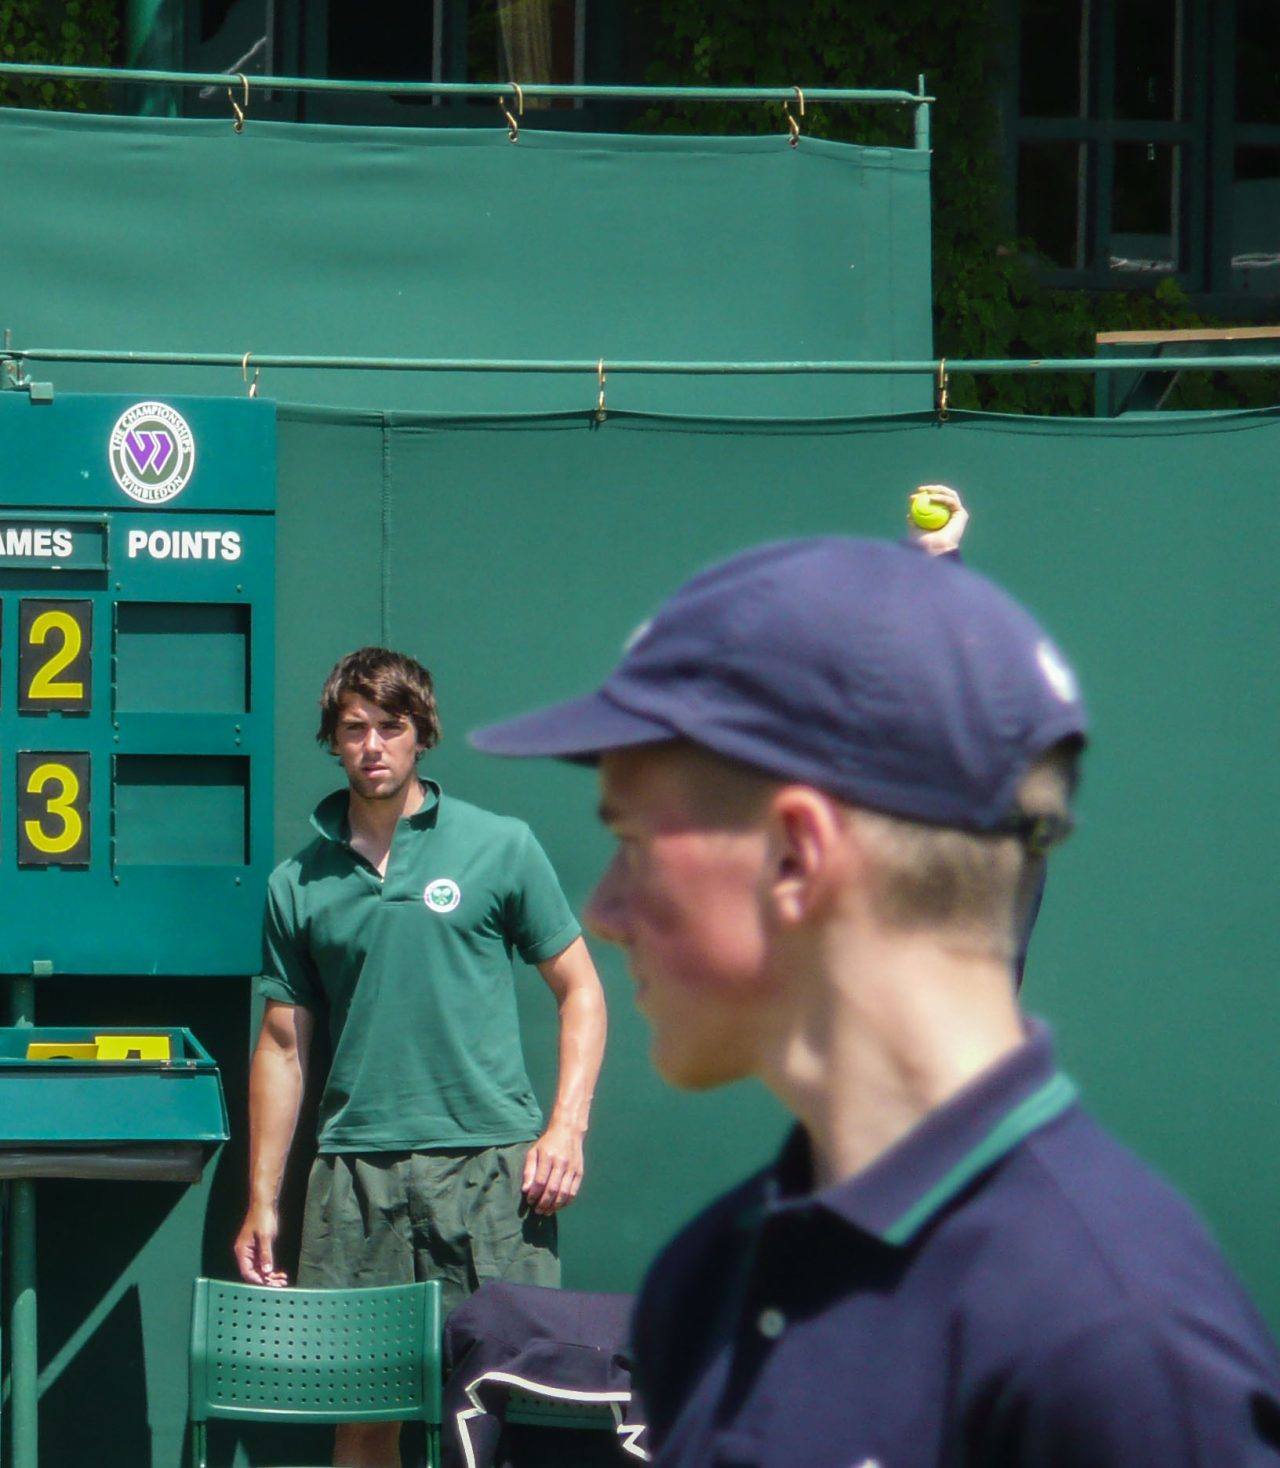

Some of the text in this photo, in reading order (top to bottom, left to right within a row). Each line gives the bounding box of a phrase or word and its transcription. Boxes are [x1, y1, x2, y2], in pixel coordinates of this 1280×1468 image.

[122, 405, 192, 453] CHAMPIONSHIPS
[120, 474, 184, 500] WIMBLEDON
[127, 530, 242, 561] POINTS
[27, 610, 84, 700] 2
[24, 762, 83, 854] 3
